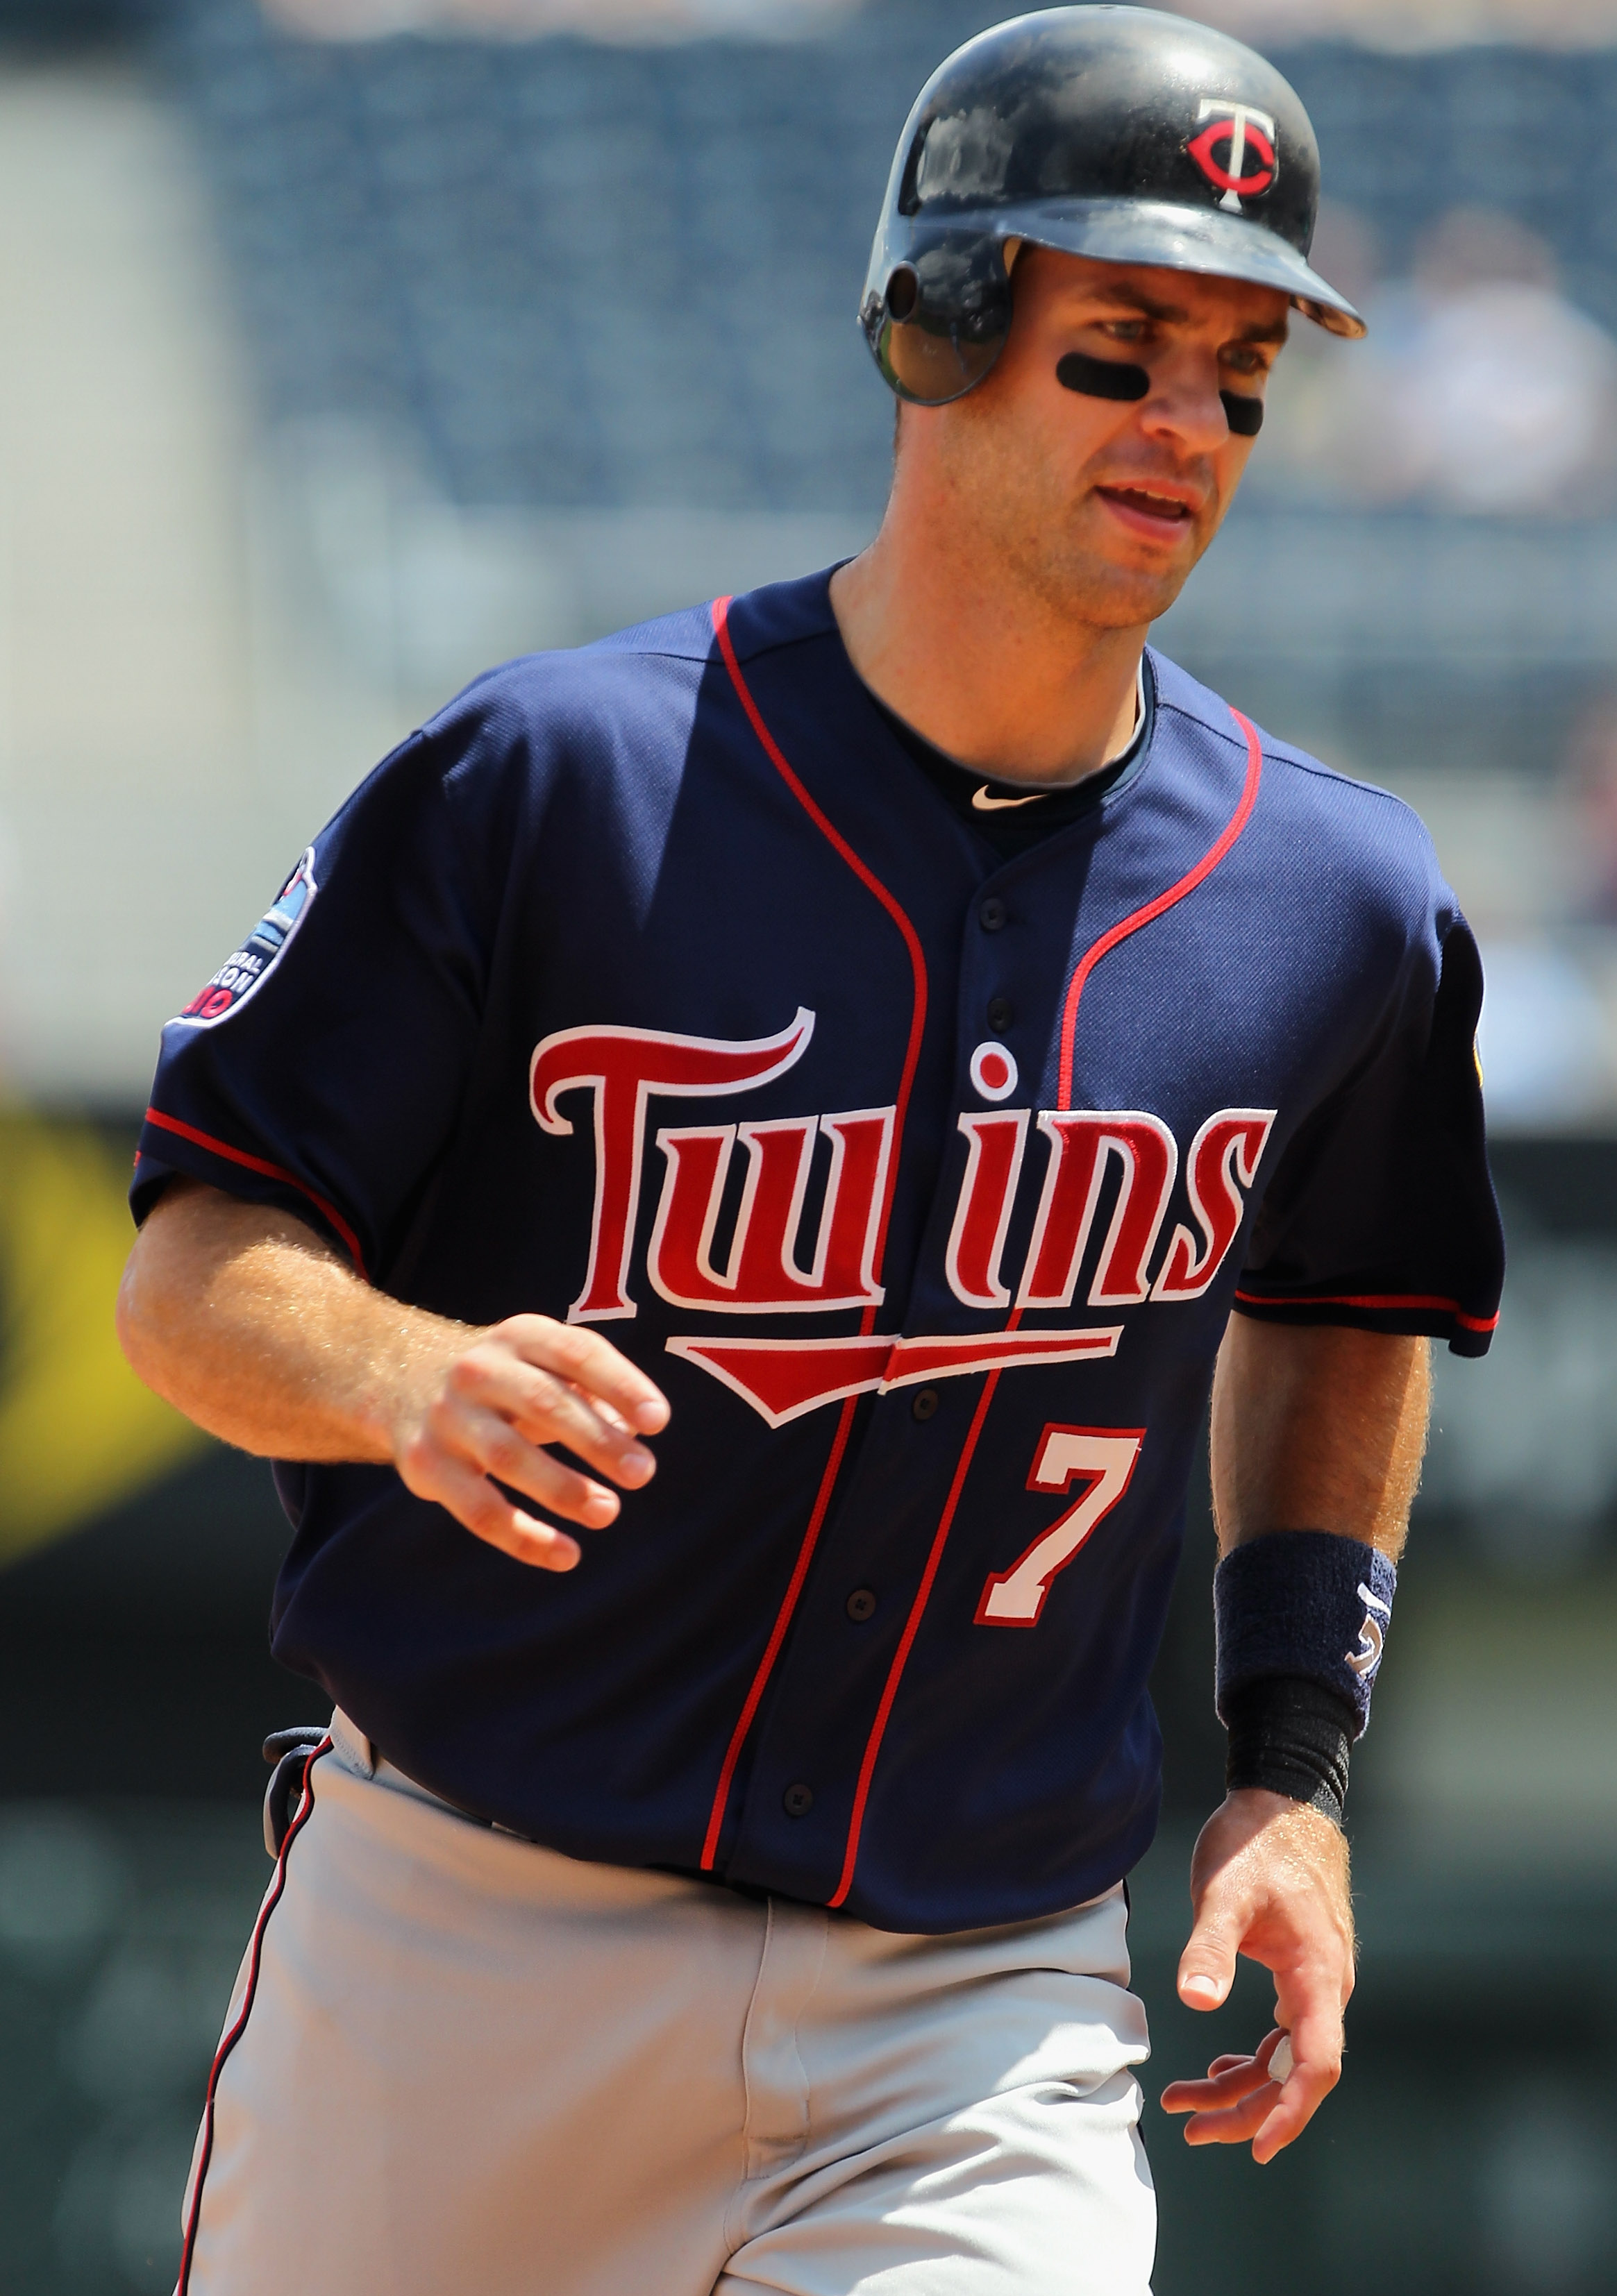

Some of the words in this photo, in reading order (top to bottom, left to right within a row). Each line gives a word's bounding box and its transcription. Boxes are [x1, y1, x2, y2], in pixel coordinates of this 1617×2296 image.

[181, 986, 233, 1018] 10
[205, 965, 254, 993] SON
[530, 1006, 1277, 1324] Twins
[973, 1422, 1146, 1628] 7
